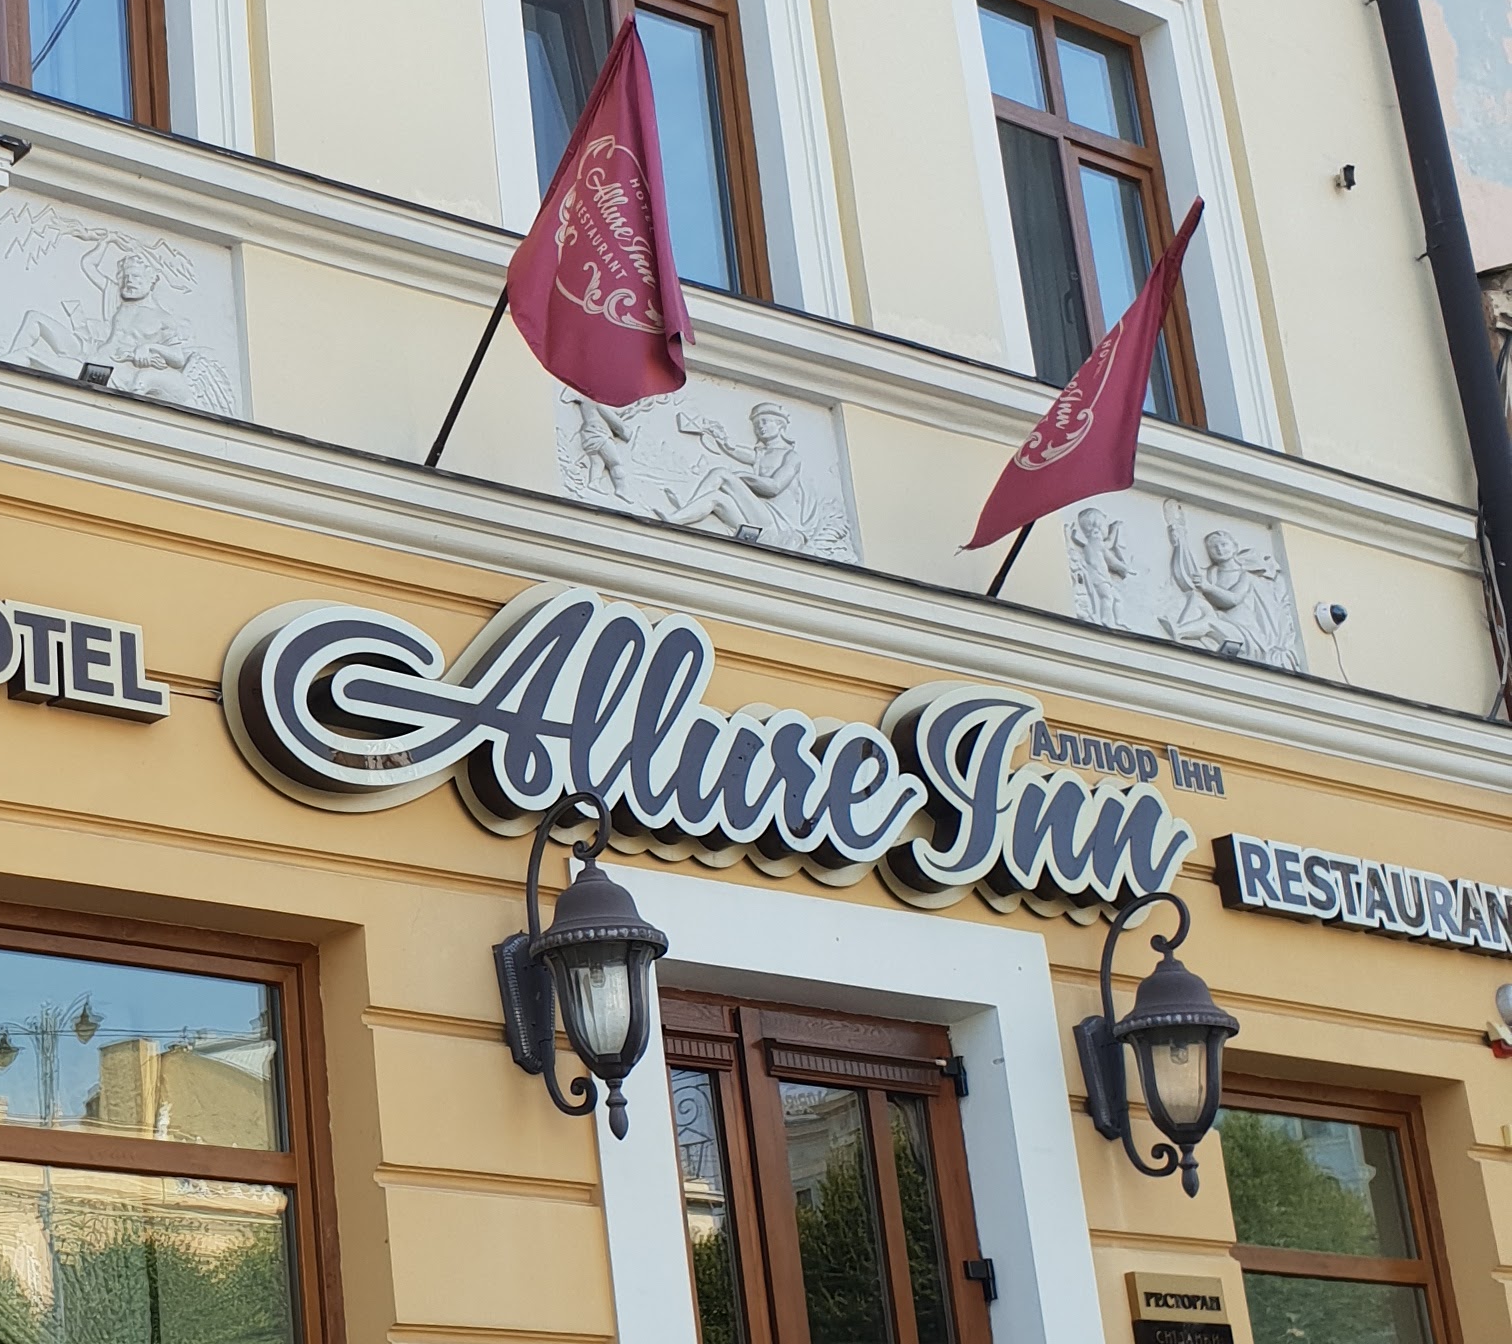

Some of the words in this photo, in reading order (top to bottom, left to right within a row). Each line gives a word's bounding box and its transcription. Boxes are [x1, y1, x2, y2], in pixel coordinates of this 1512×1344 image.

[575, 200, 628, 279] RESTAURANT
[586, 167, 634, 241] Allure
[619, 235, 656, 289] Inn
[629, 177, 655, 234] HOTEL
[266, 596, 921, 854] Allure
[922, 694, 1191, 896] Inn
[1032, 719, 1160, 783] Аллюр
[1168, 747, 1226, 796] Інн
[1143, 1291, 1222, 1312] РЕСТОРАН
